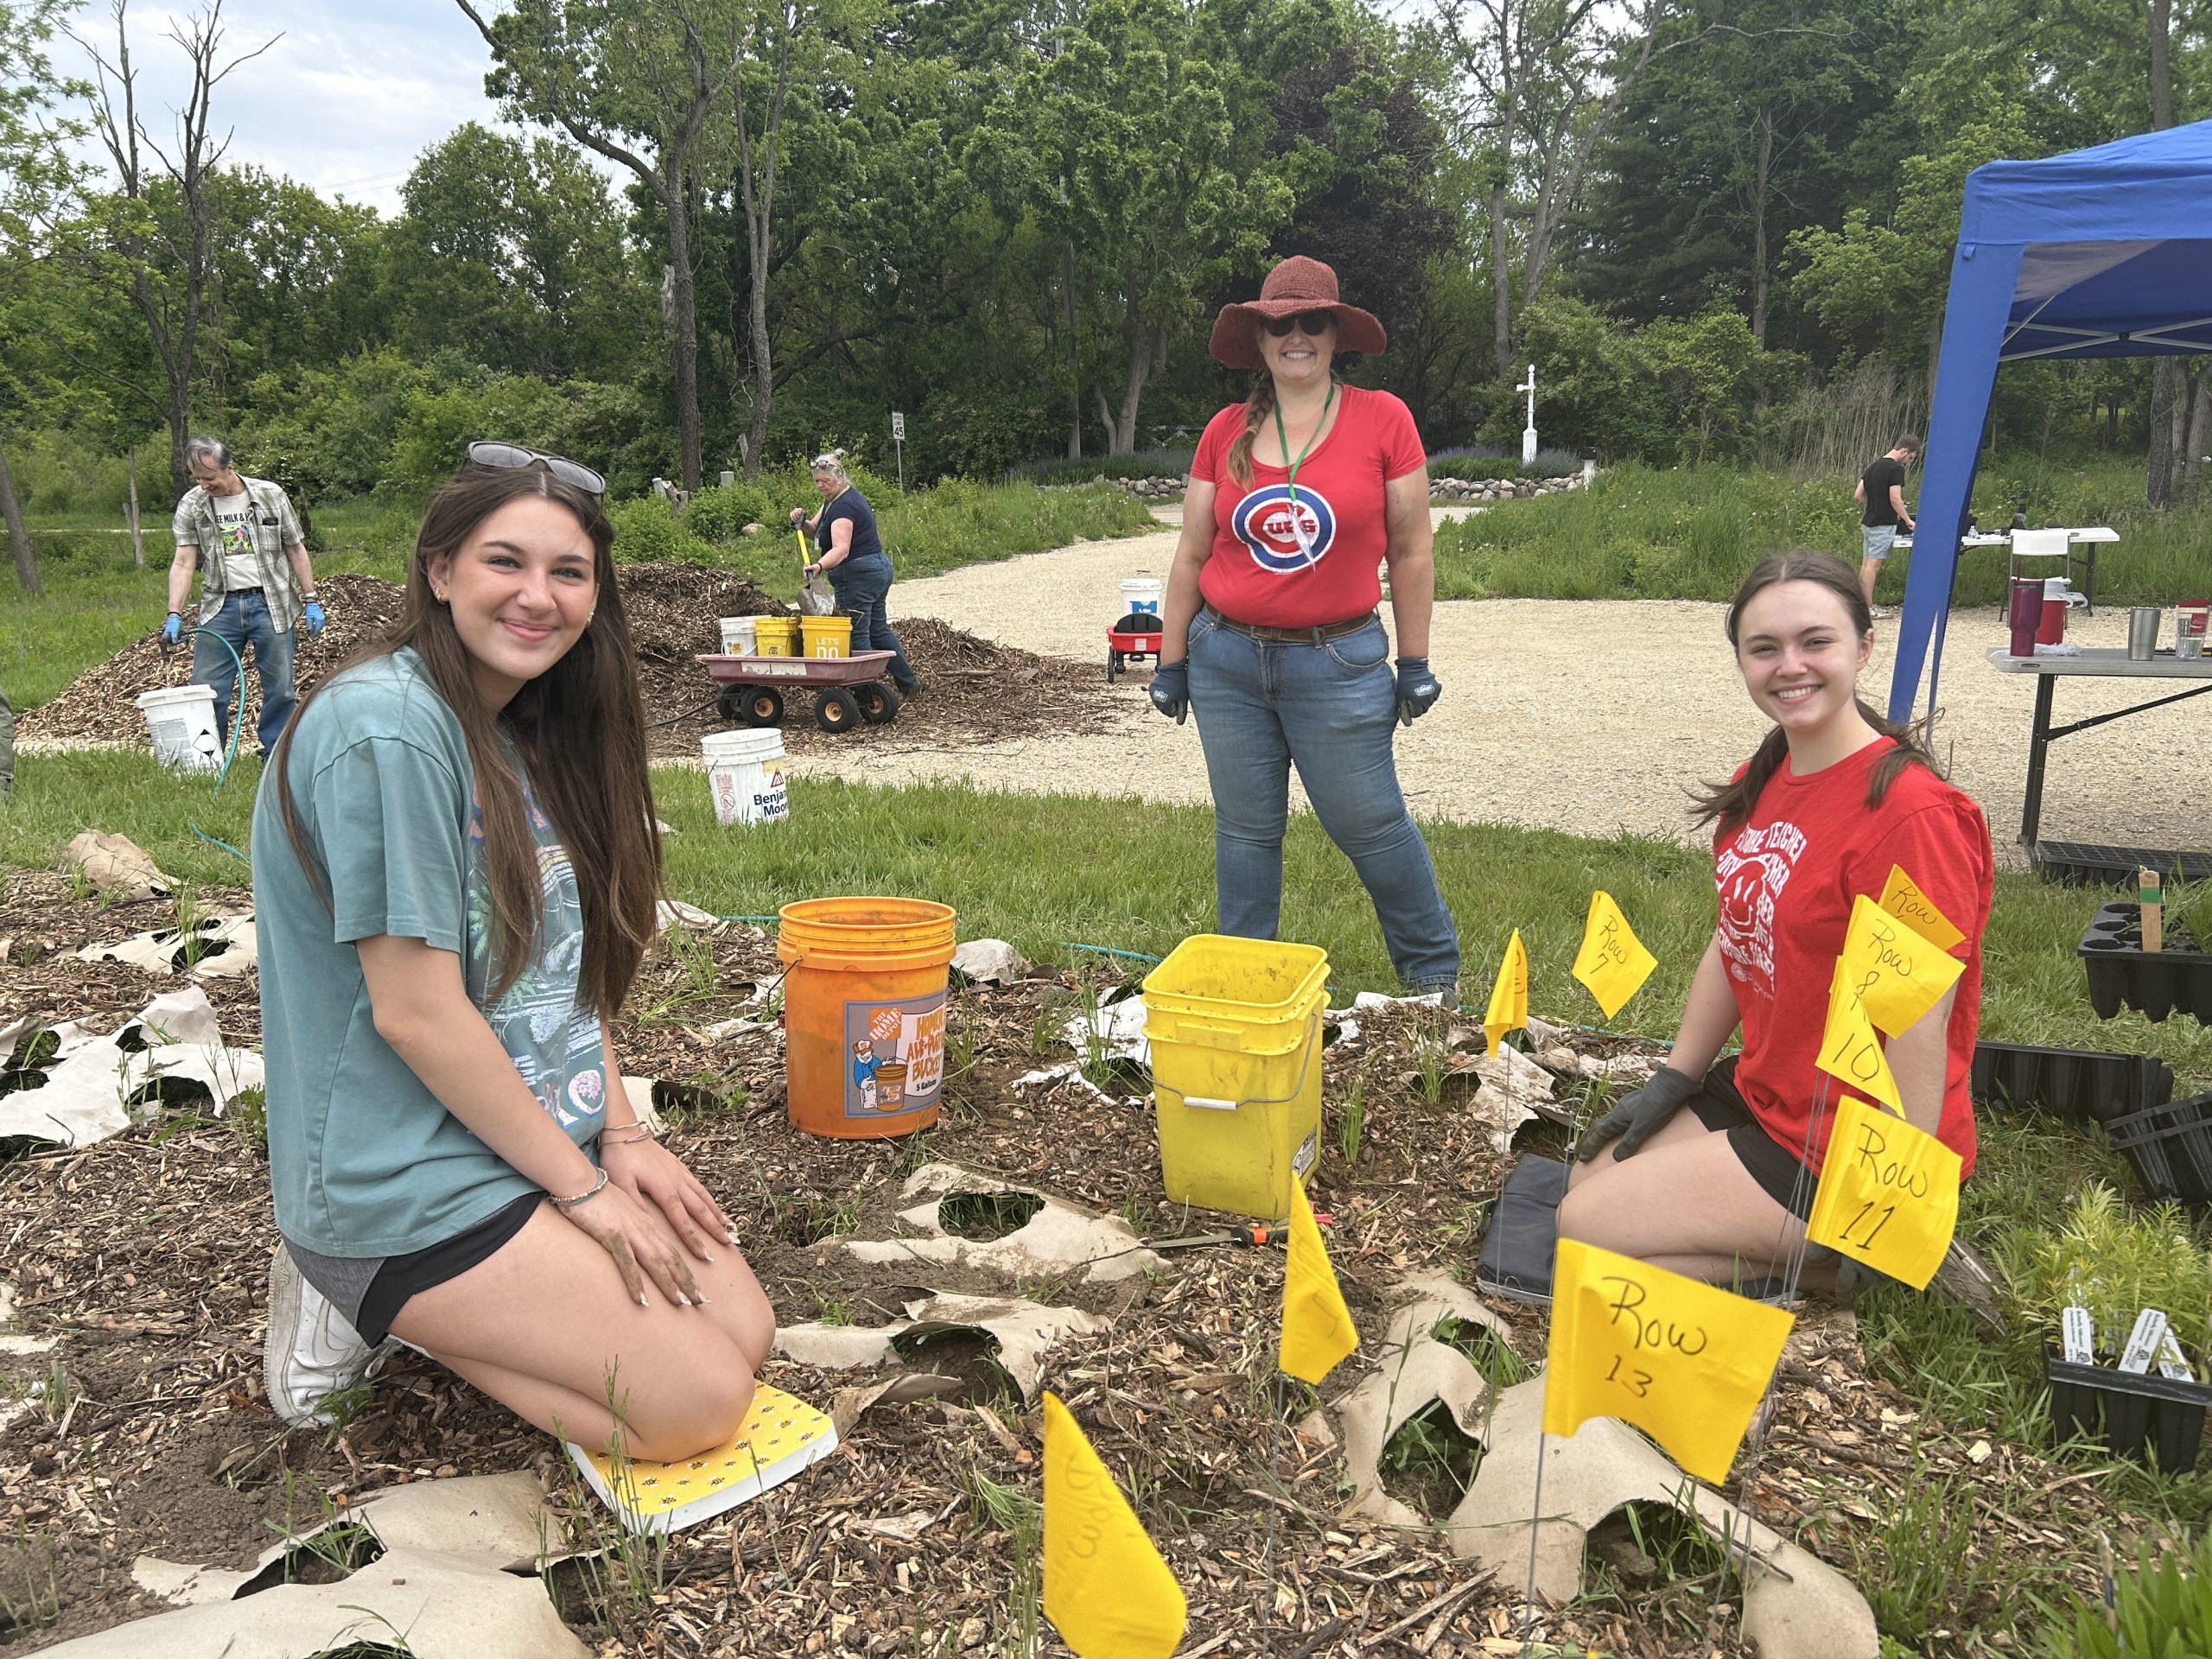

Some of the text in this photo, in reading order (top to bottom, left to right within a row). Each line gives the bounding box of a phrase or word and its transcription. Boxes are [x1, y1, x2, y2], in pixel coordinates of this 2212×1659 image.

[894, 426, 904, 437] 45
[223, 513, 238, 523] MILK
[816, 637, 839, 645] LET'S
[1891, 879, 1937, 925] Row
[1599, 914, 1629, 964] Row
[1866, 918, 1912, 977] Row
[1589, 952, 1610, 975] 7
[1858, 970, 1880, 995] 8
[869, 1007, 901, 1040] HOME
[873, 1011, 888, 1026] THE
[880, 1019, 902, 1041] DEPOT
[912, 1053, 941, 1083] BUCKET
[1833, 1032, 1880, 1083] 10
[916, 1077, 938, 1091] 5 Gallons
[1858, 1122, 1928, 1198] Row
[1838, 1201, 1896, 1251] 11
[1600, 1275, 1707, 1356] Row
[1605, 1354, 1653, 1398] 13
